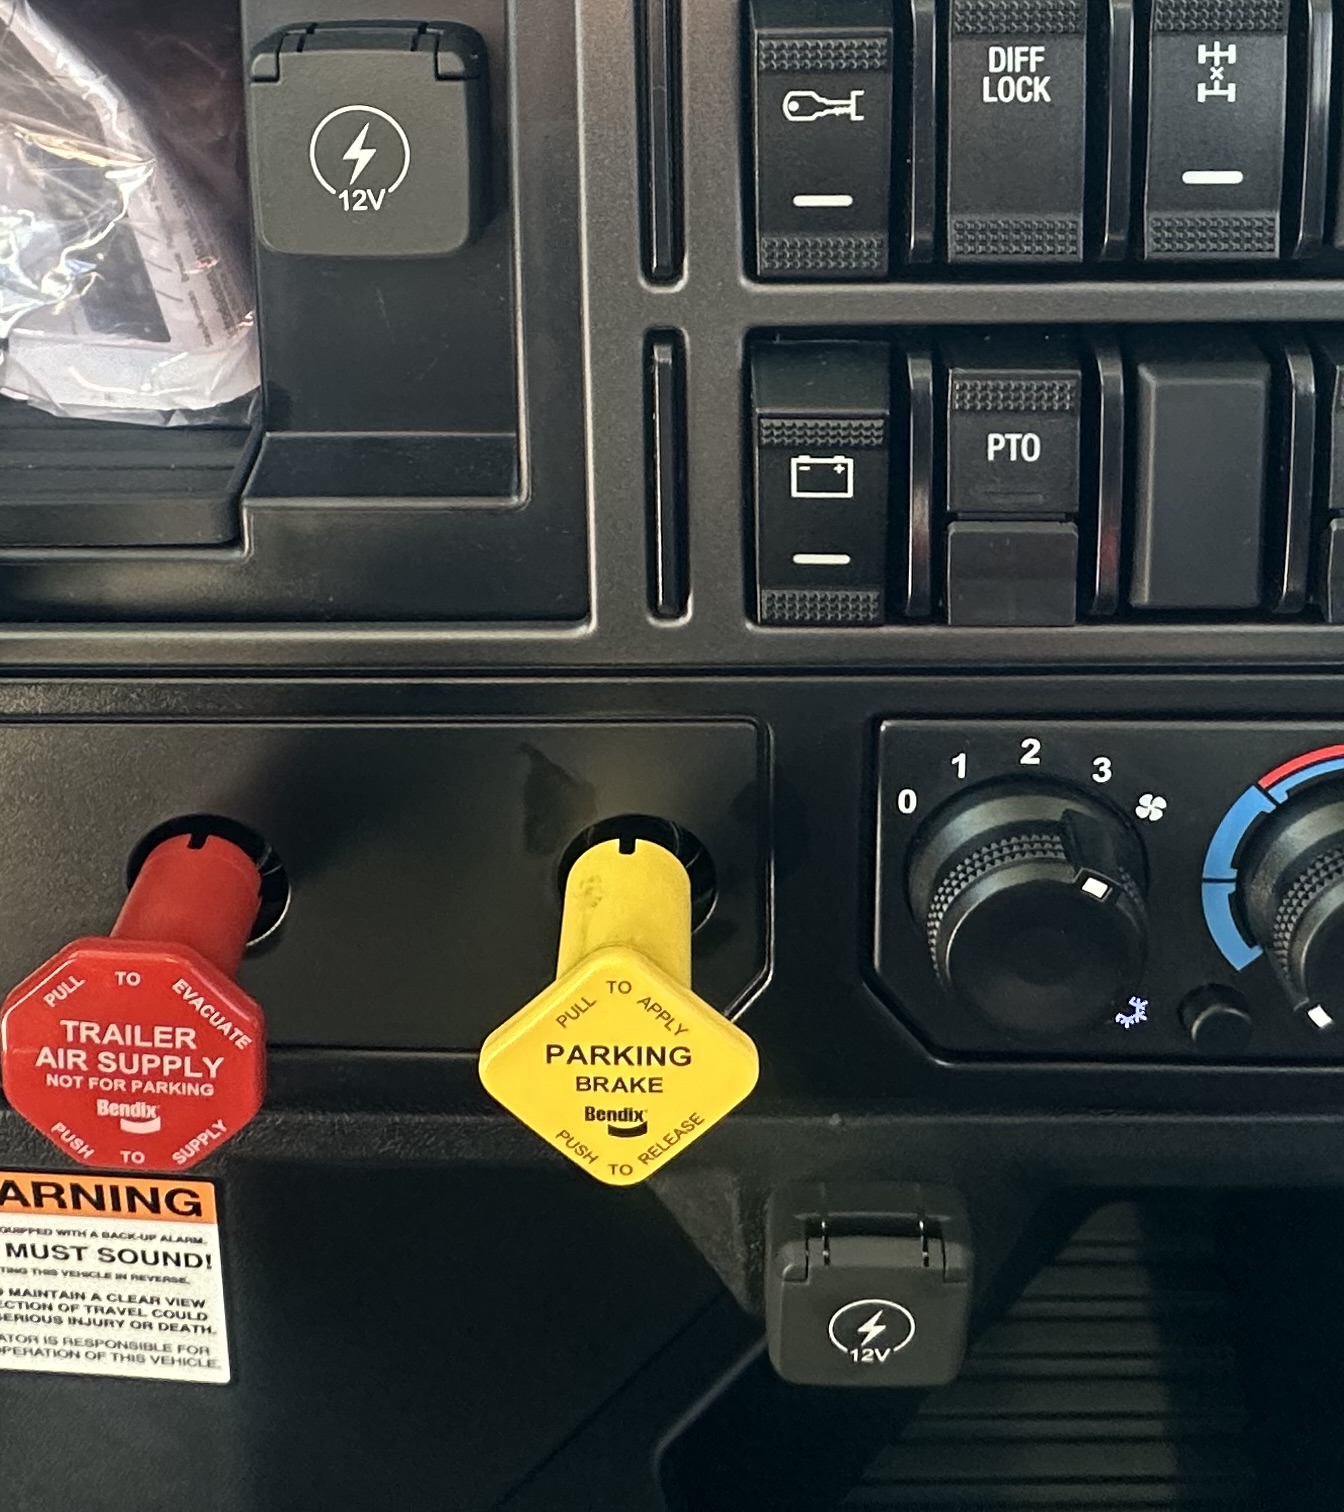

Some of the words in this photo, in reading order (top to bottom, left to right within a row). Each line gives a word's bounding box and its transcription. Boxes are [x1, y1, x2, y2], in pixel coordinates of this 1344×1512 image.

[989, 46, 1046, 73] DIFF
[983, 76, 1051, 103] LOCK
[338, 188, 386, 211] 12V
[986, 433, 1041, 463] PTO
[1020, 738, 1041, 765] 2
[951, 752, 967, 779] 1
[1092, 756, 1112, 783] 3
[898, 788, 918, 814] 0
[43, 973, 86, 1008] PULL
[114, 971, 141, 986] TO
[171, 978, 253, 1050] EVACUATE
[556, 996, 598, 1029] PULL
[606, 980, 633, 995] TO
[636, 996, 689, 1037] APPLY
[59, 1019, 198, 1050] TRAILER
[35, 1046, 88, 1072] AIR
[97, 1051, 225, 1078] SUPPLY
[545, 1043, 692, 1067] PARKING
[46, 1073, 84, 1089] NOT
[88, 1077, 127, 1093] FOR
[131, 1080, 215, 1097] PARKING
[575, 1076, 664, 1094] BRAKE
[96, 1098, 158, 1119] Bendix
[584, 1106, 645, 1123] Bendix
[51, 1121, 95, 1160] PUSH
[120, 1150, 146, 1165] TO
[171, 1118, 228, 1166] SUPPLY
[555, 1129, 599, 1165] PUSH
[608, 1163, 634, 1176] TO
[637, 1112, 706, 1166] RELEASE
[56, 1229, 87, 1238] WITH
[90, 1231, 98, 1239] A
[102, 1231, 157, 1241] BACK-UP
[160, 1235, 208, 1245] ALARM.
[5, 1243, 88, 1261] MUST
[97, 1247, 212, 1269] SOUND!
[31, 1266, 58, 1276] THIS
[61, 1269, 112, 1279] VEHICLE
[115, 1272, 127, 1280] IN
[8, 1287, 86, 1300] MAINTAIN
[91, 1292, 102, 1302] A
[106, 1293, 161, 1305] CLEAR
[165, 1296, 206, 1308] VIEW
[57, 1303, 79, 1313] OF
[84, 1304, 148, 1317] TRAVEL
[152, 1309, 208, 1321] COULD
[68, 1316, 125, 1328] INJURY
[130, 1320, 153, 1330] OR
[158, 1321, 217, 1335] DEATH.
[43, 1335, 58, 1346] IS
[63, 1337, 173, 1353] RESPONSIBLE
[177, 1344, 210, 1356] FOR
[850, 1348, 891, 1362] 12V
[84, 1350, 107, 1360] OF
[110, 1352, 146, 1363] THIS
[149, 1355, 221, 1369] VEHICLE.
